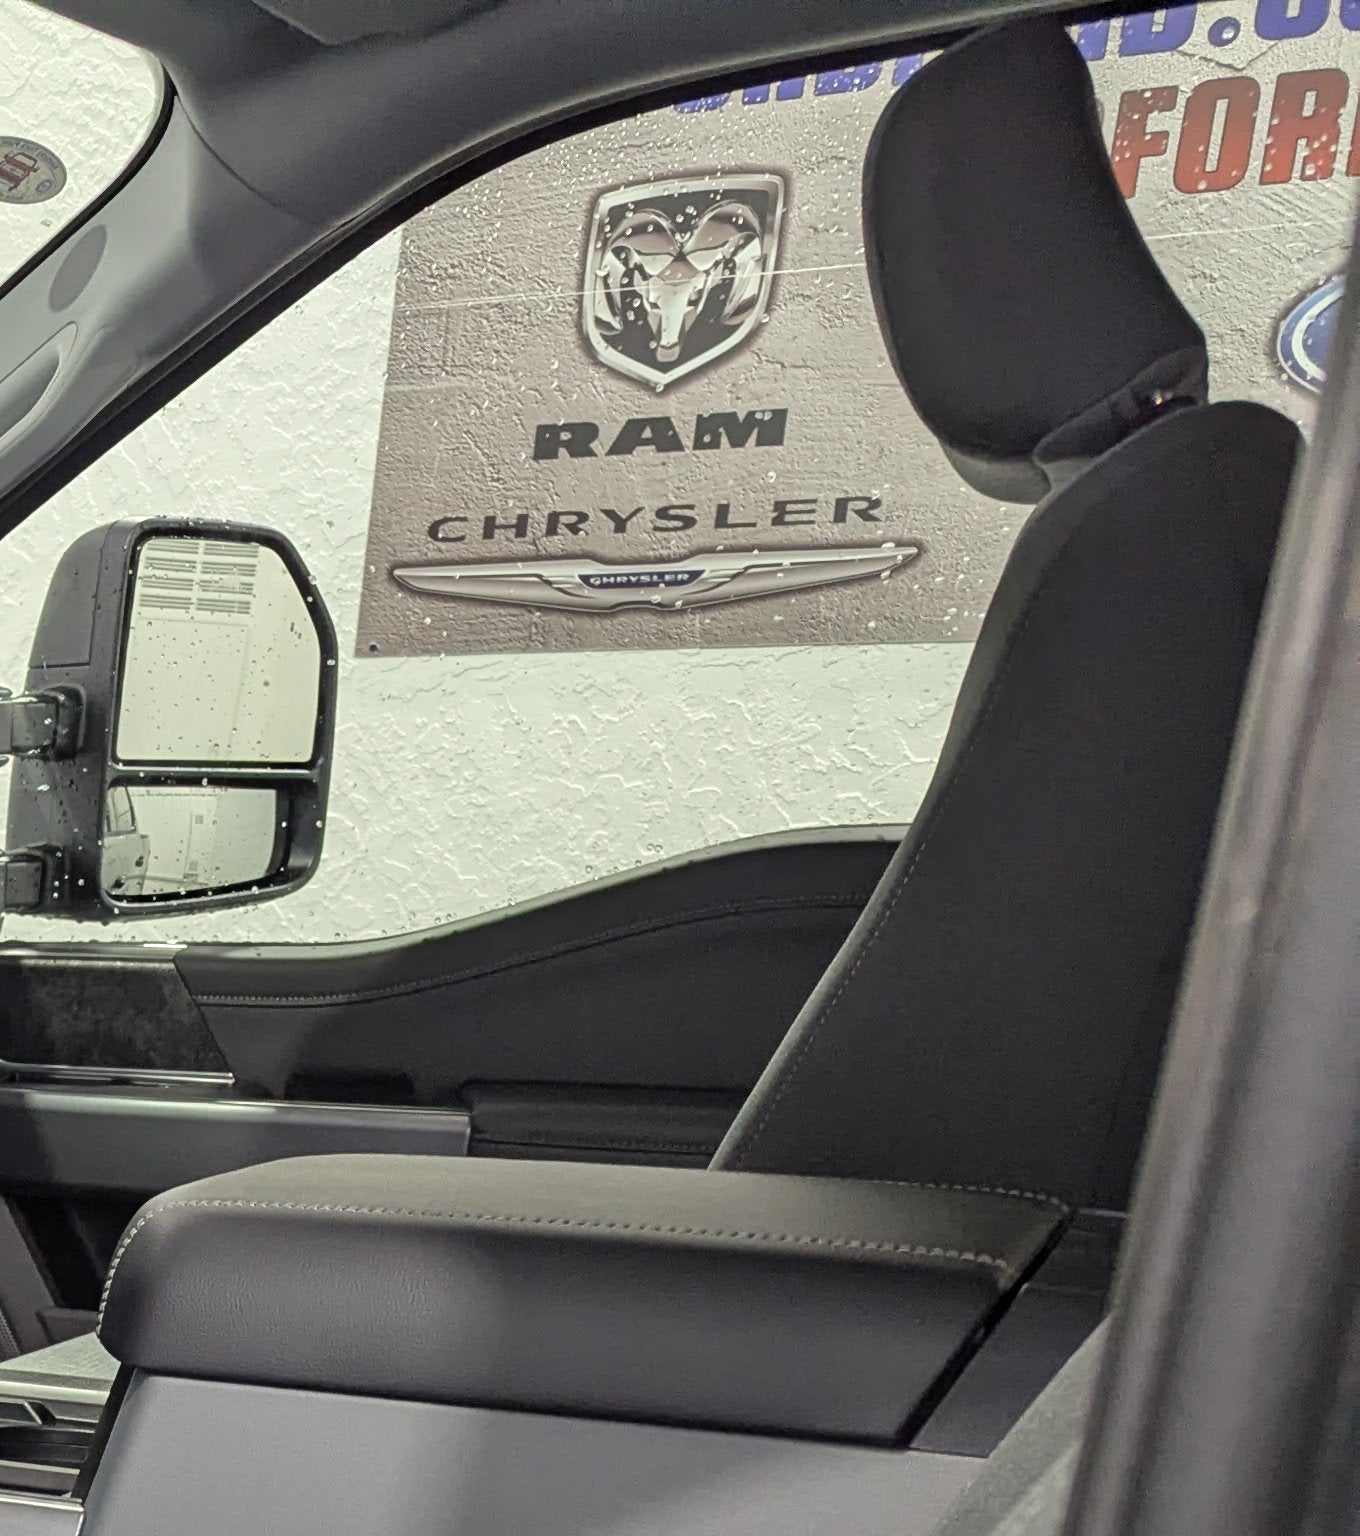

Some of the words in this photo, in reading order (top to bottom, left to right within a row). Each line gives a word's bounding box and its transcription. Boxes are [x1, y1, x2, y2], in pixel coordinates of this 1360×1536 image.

[1112, 68, 1360, 199] FOR
[532, 407, 788, 461] RAM
[426, 496, 882, 543] CHRYSLER
[589, 573, 690, 586] CHRYSLER
